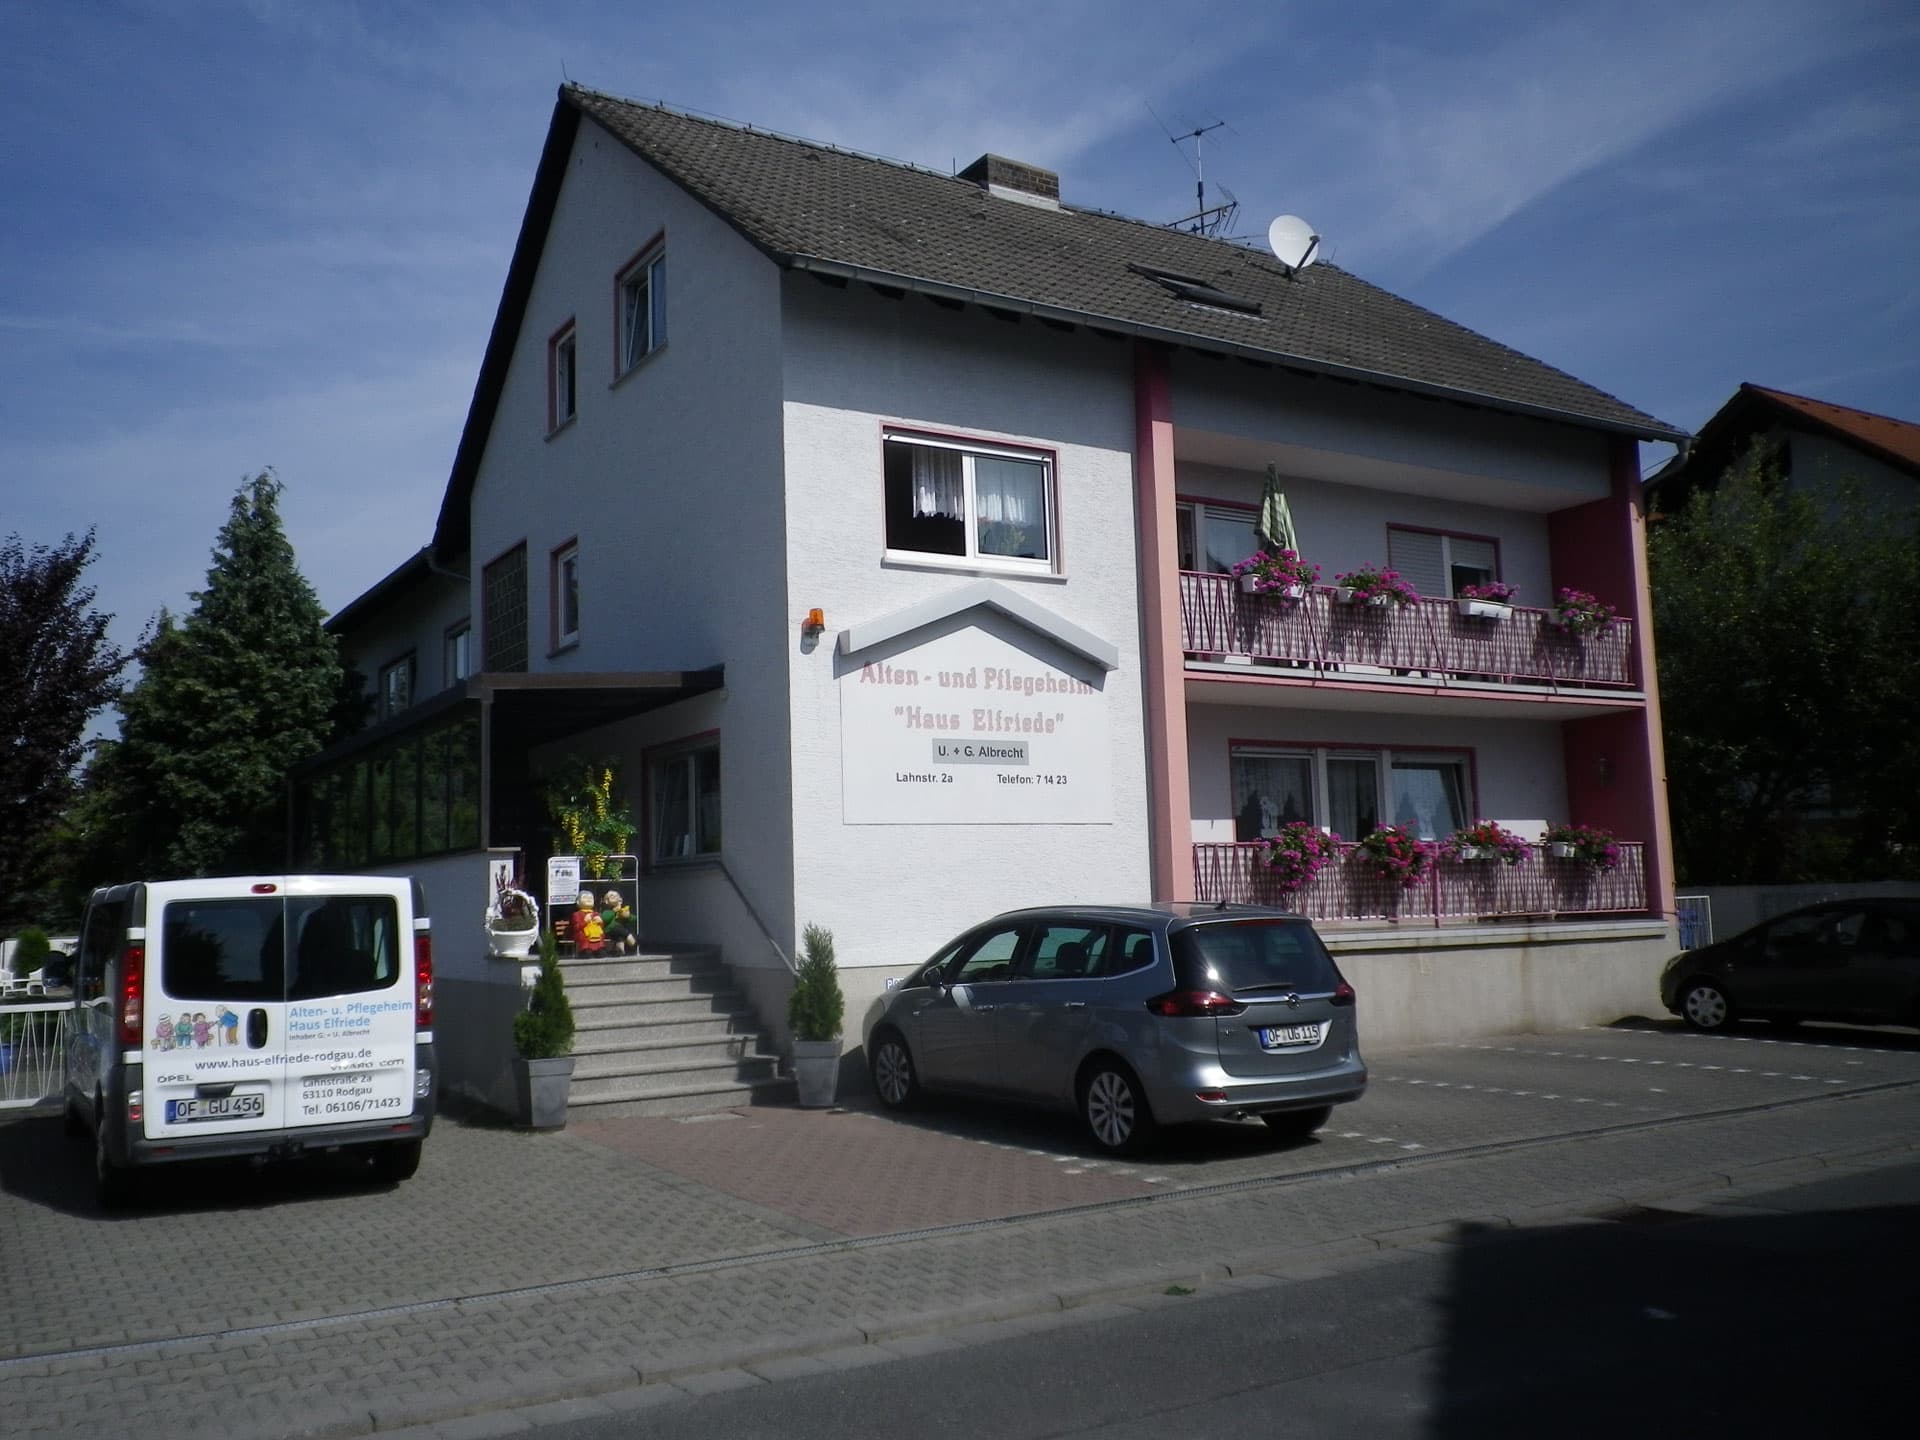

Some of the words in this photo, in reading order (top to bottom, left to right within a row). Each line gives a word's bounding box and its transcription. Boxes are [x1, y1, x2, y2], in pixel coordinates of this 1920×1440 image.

[860, 661, 919, 686] Alten
[938, 667, 977, 689] und
[984, 667, 1093, 696] Pflegeheim
[894, 705, 960, 730] "Haus
[972, 709, 1064, 733] Elfriede"
[938, 745, 949, 757] U.
[954, 747, 960, 755] +
[964, 746, 975, 757] G.
[978, 746, 1024, 759] Albrecht
[896, 772, 938, 783] Lahnstr.
[941, 773, 953, 783] 2a
[997, 774, 1034, 784] Telefon:
[1036, 775, 1042, 784] 7
[1044, 775, 1054, 785] 14
[1056, 775, 1067, 785] 23
[289, 1007, 328, 1019] Alten-
[331, 1007, 343, 1016] u.
[347, 1001, 413, 1015] Pflegeheim
[289, 1021, 321, 1031] Haus
[324, 1017, 371, 1029] Elfriede
[1269, 1028, 1281, 1042] OF
[1287, 1026, 1301, 1040] UG
[1302, 1025, 1319, 1040] 115
[195, 1048, 372, 1071] www.haus-elfriede-rodgau.de
[157, 1074, 193, 1083] OPEL
[360, 1074, 373, 1083] 2a
[302, 1089, 333, 1100] 63110
[335, 1087, 373, 1097] Rodgau
[177, 1102, 198, 1117] OF
[209, 1099, 230, 1114] GU
[233, 1097, 261, 1112] 456
[303, 1104, 323, 1115] Tel.
[325, 1096, 401, 1113] 06106/71423
